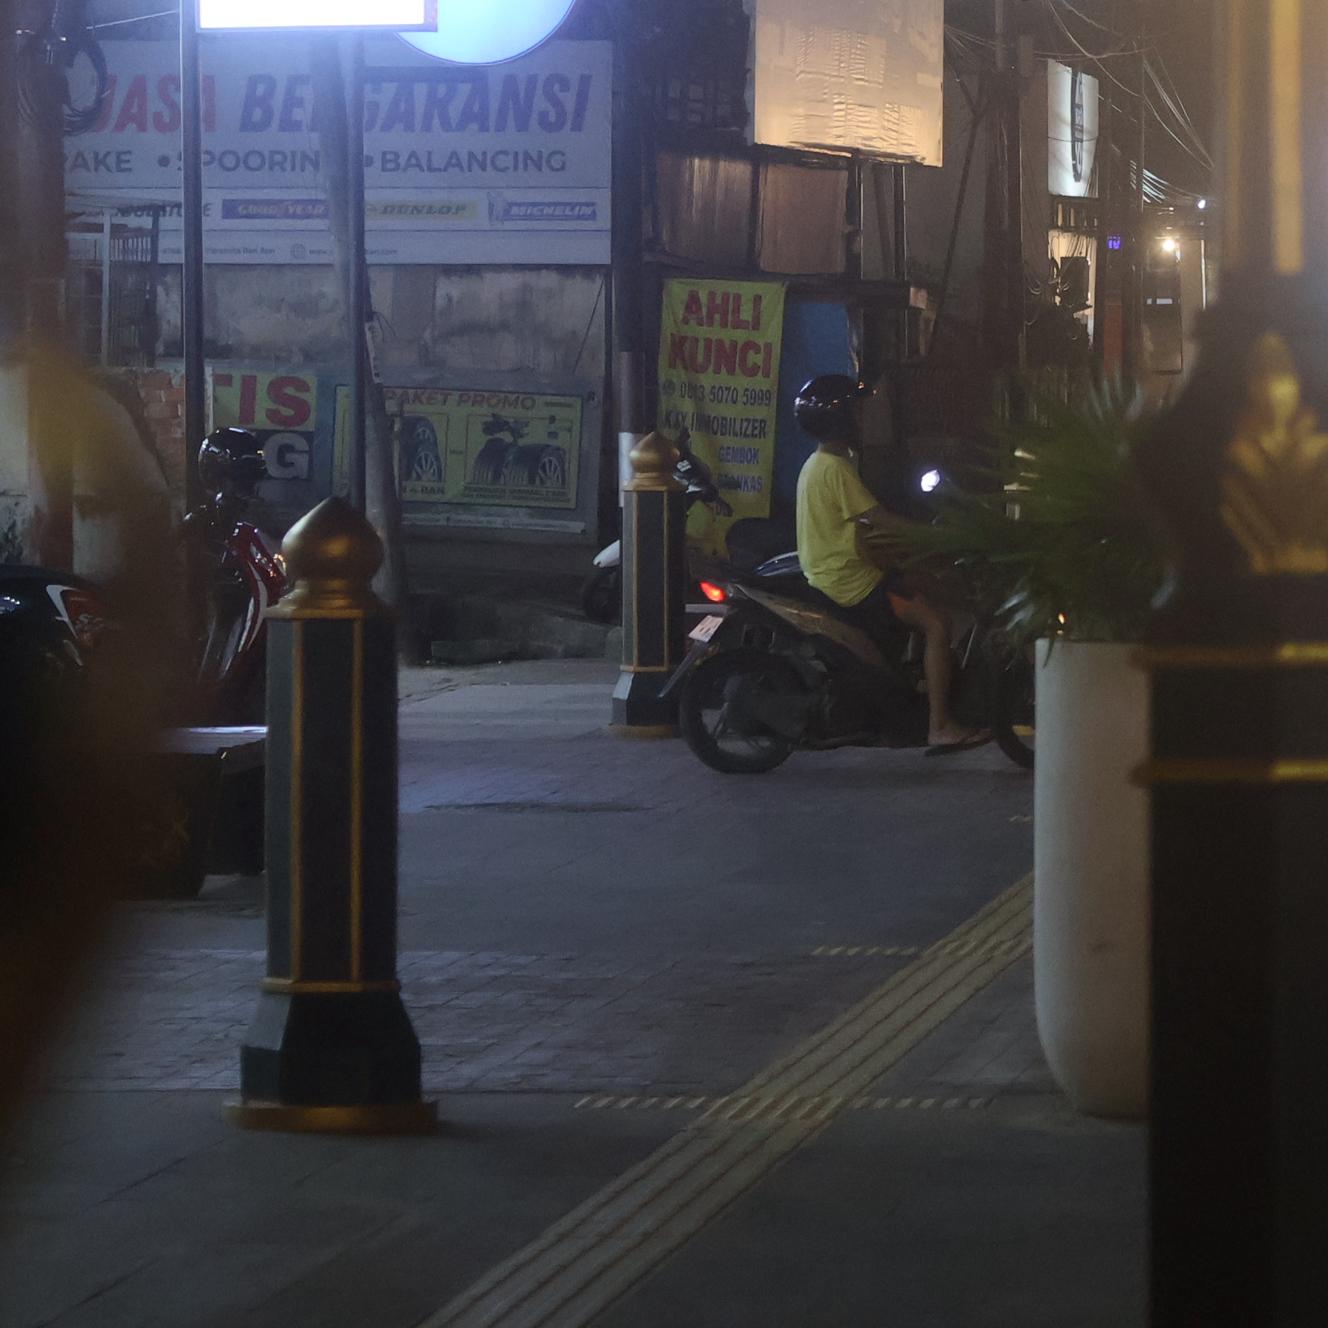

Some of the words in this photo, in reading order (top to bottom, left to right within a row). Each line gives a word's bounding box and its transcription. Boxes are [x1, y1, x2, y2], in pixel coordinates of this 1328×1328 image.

[66, 150, 133, 173] AKE
[177, 150, 323, 174] POORIN
[379, 150, 568, 174] BALANCING
[380, 204, 467, 216] DUNLOP
[509, 205, 593, 217] MICHELIN
[682, 289, 763, 332] AHLI
[668, 332, 773, 379] KUNCI
[384, 388, 453, 407] PAKET
[457, 392, 537, 411] PROMO
